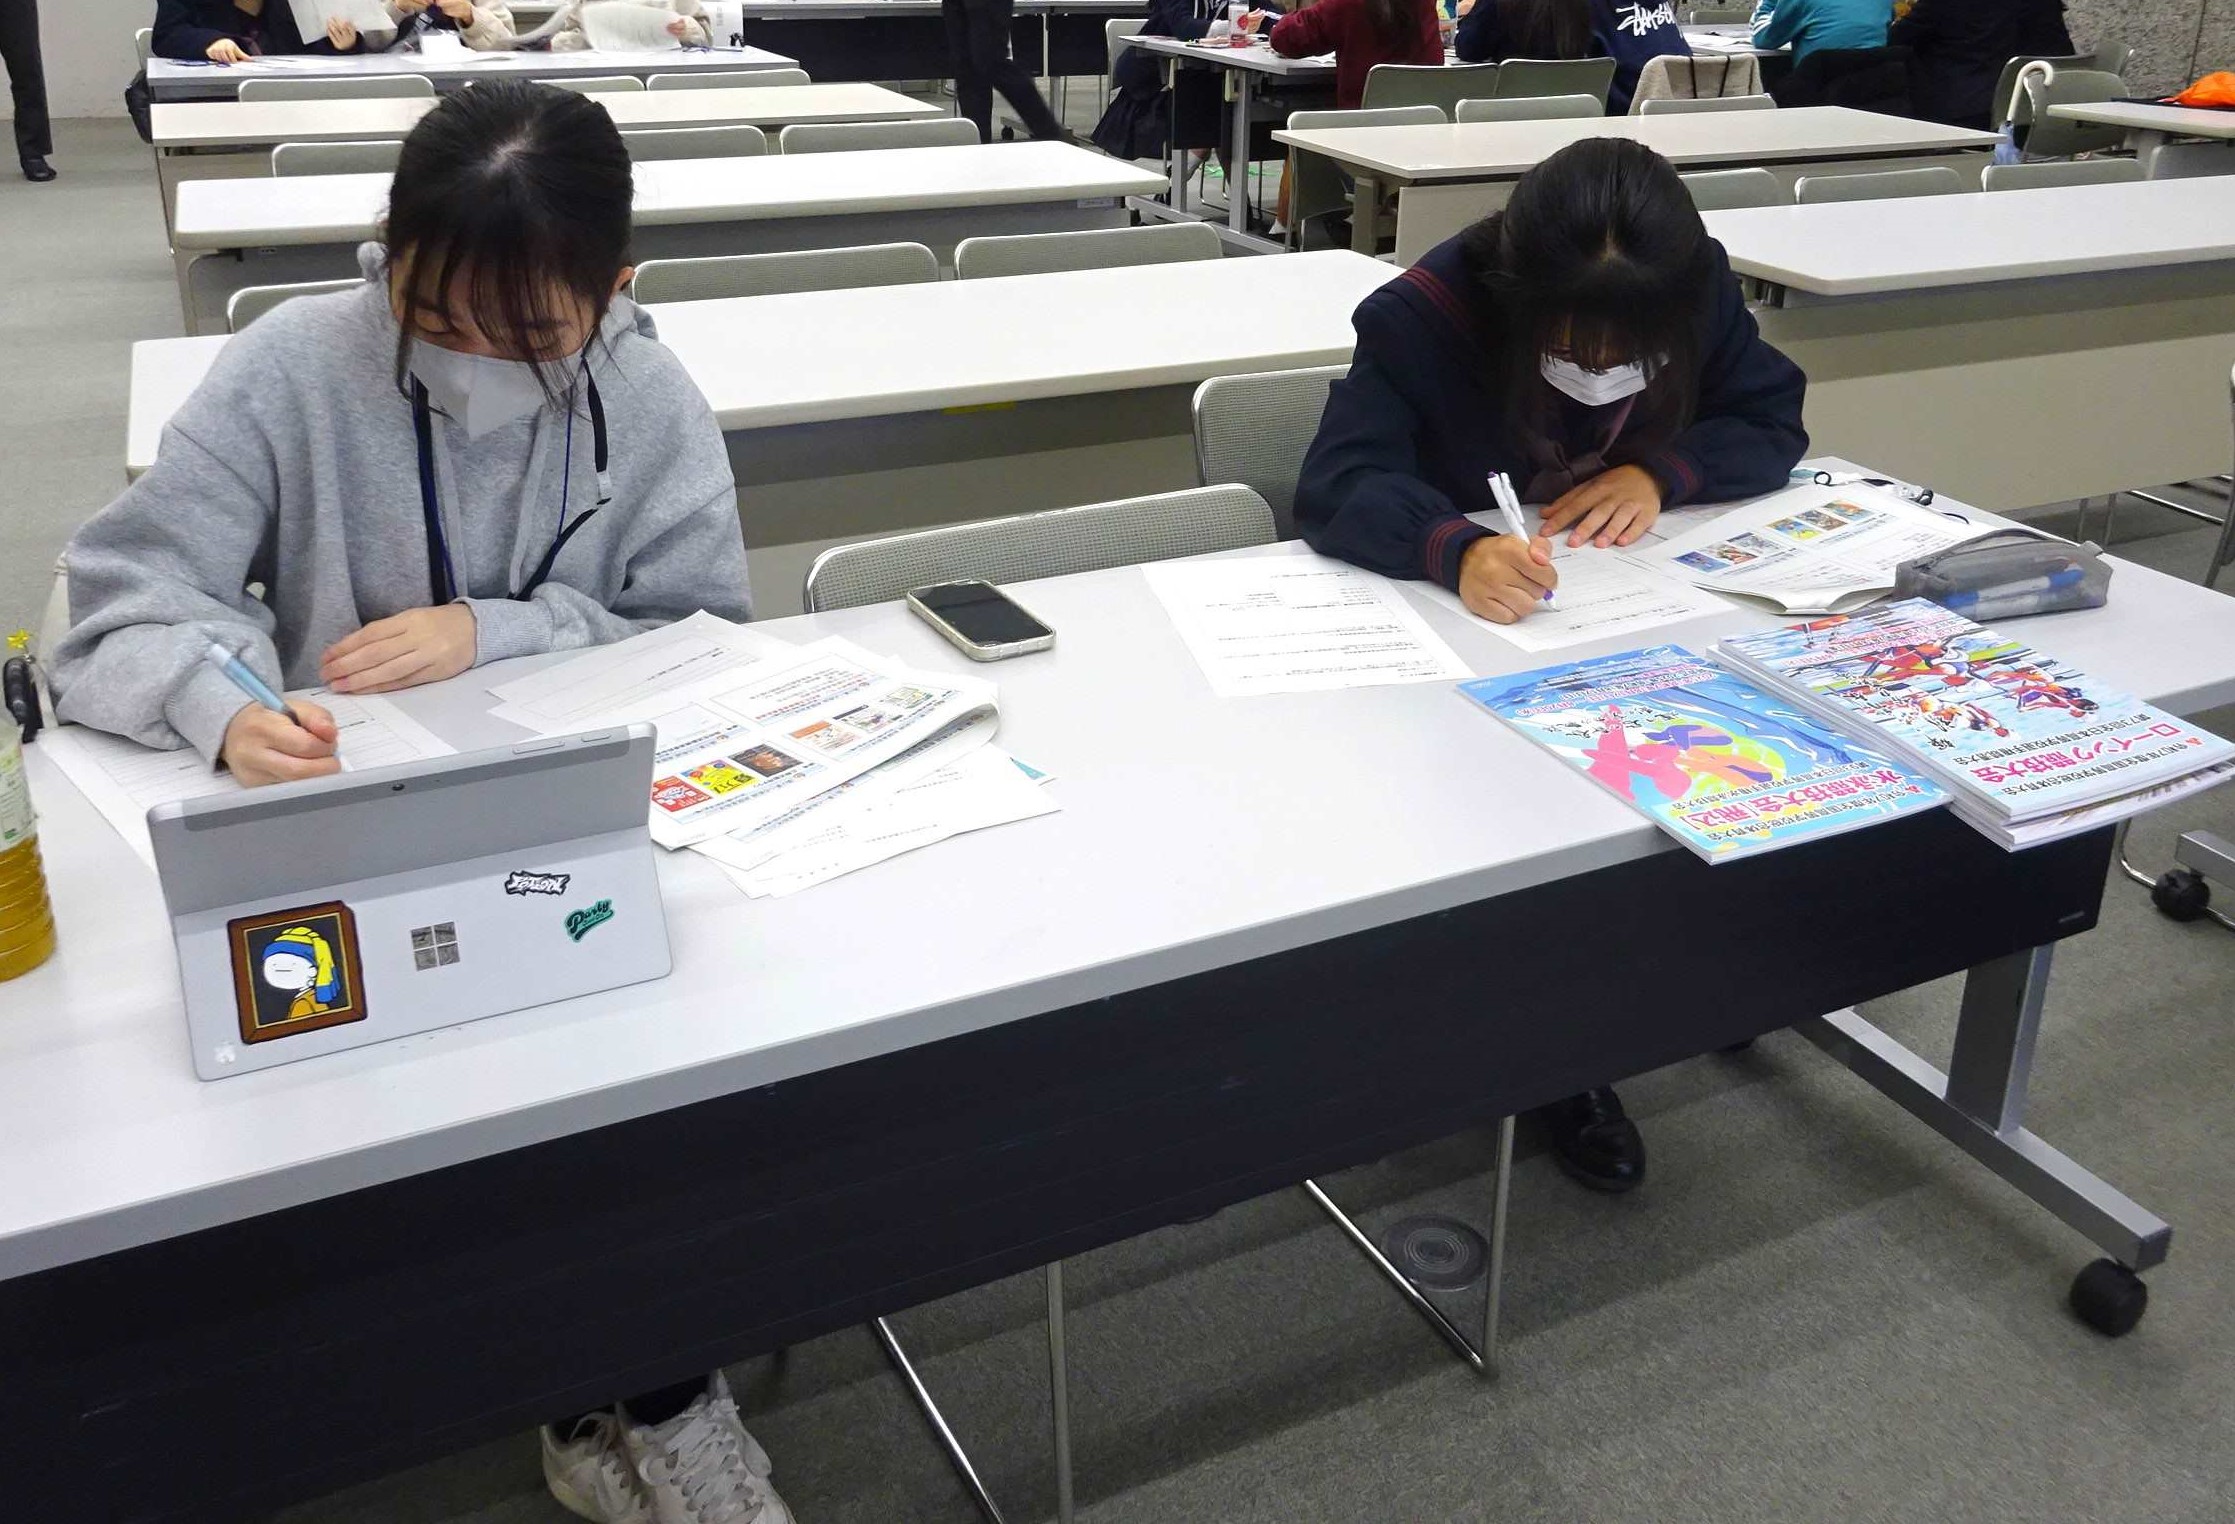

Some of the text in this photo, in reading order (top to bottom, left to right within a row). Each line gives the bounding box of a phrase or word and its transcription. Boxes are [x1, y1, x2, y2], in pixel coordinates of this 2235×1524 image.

[1970, 722, 2182, 784] ローイング競技大会
[2001, 743, 2189, 796] 令和7年度全国高等学校総合体育大会
